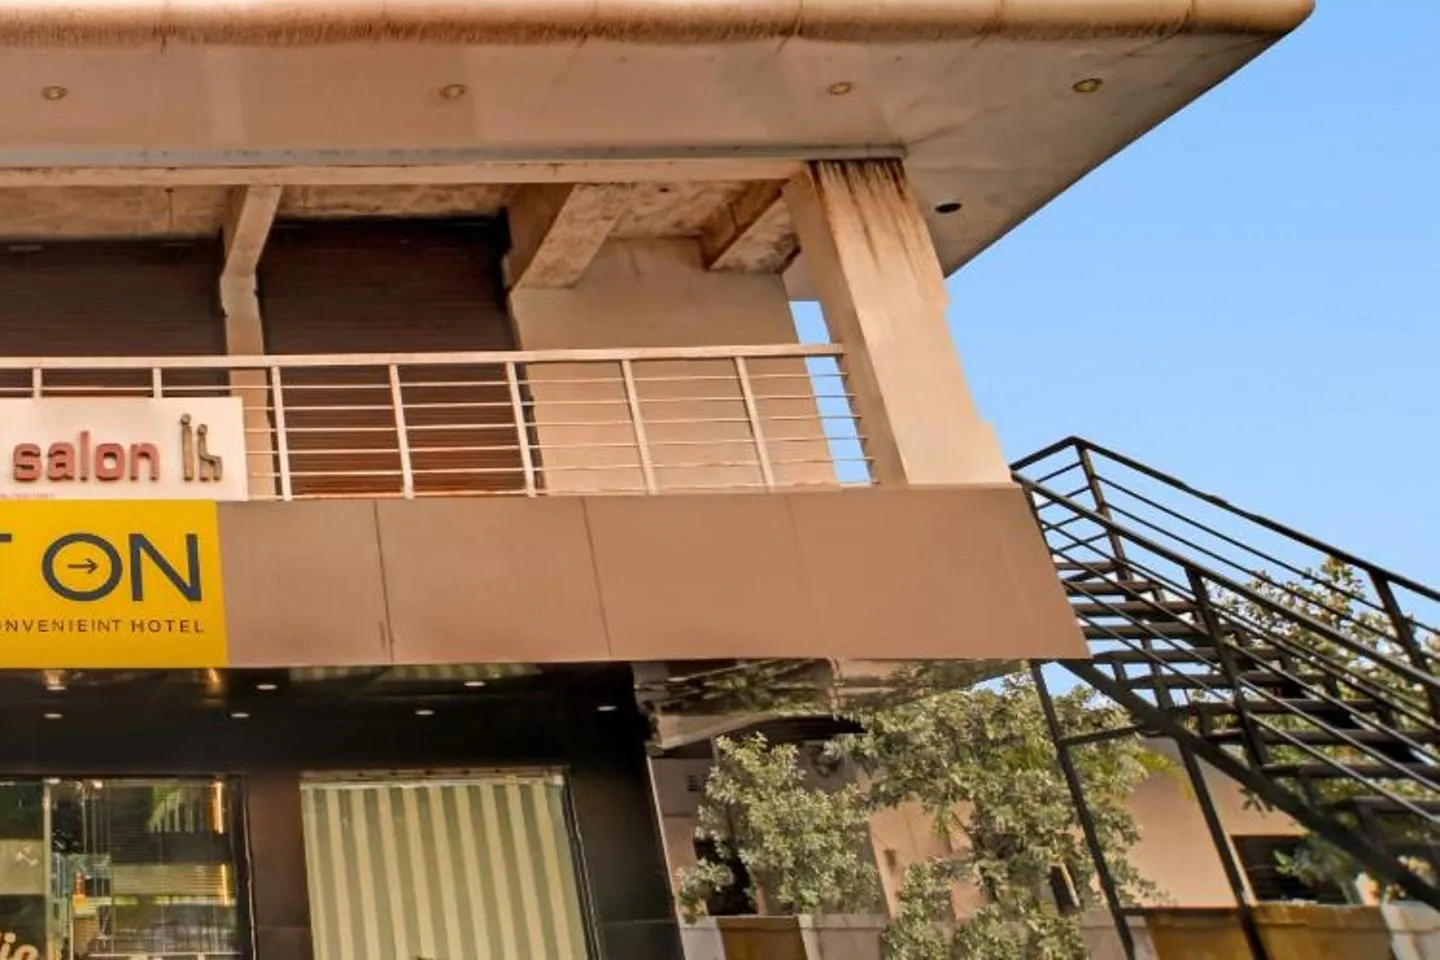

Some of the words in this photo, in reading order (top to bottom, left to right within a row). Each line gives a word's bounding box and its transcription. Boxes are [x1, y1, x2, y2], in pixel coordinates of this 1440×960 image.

[12, 431, 161, 482] salon
[41, 533, 203, 602] ON
[130, 618, 205, 634] HOTEL
